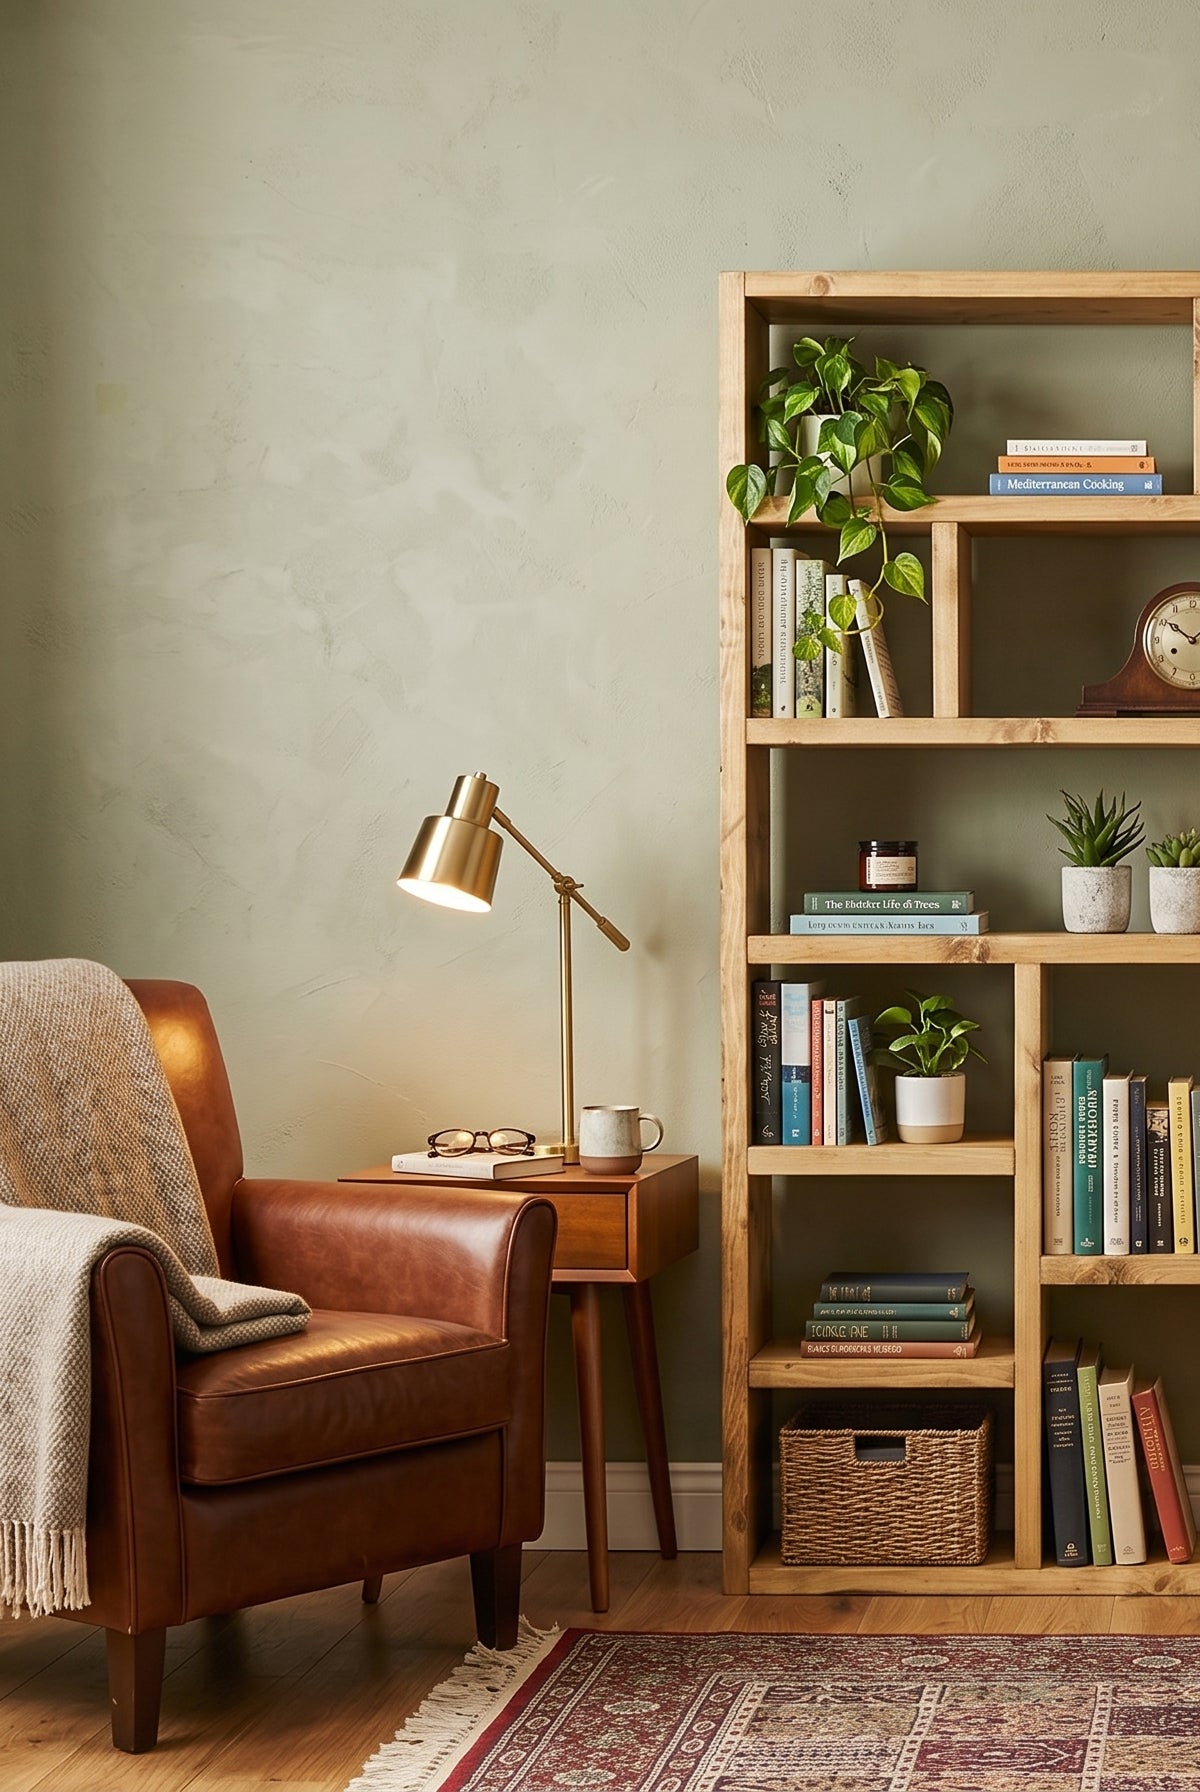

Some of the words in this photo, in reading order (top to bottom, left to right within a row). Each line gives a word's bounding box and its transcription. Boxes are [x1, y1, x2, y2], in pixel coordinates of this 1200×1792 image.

[1007, 479, 1079, 489] Mediterranean
[1083, 479, 1124, 491] Cooking
[825, 900, 843, 909] The
[882, 899, 901, 909] Life
[913, 900, 940, 909] Trees
